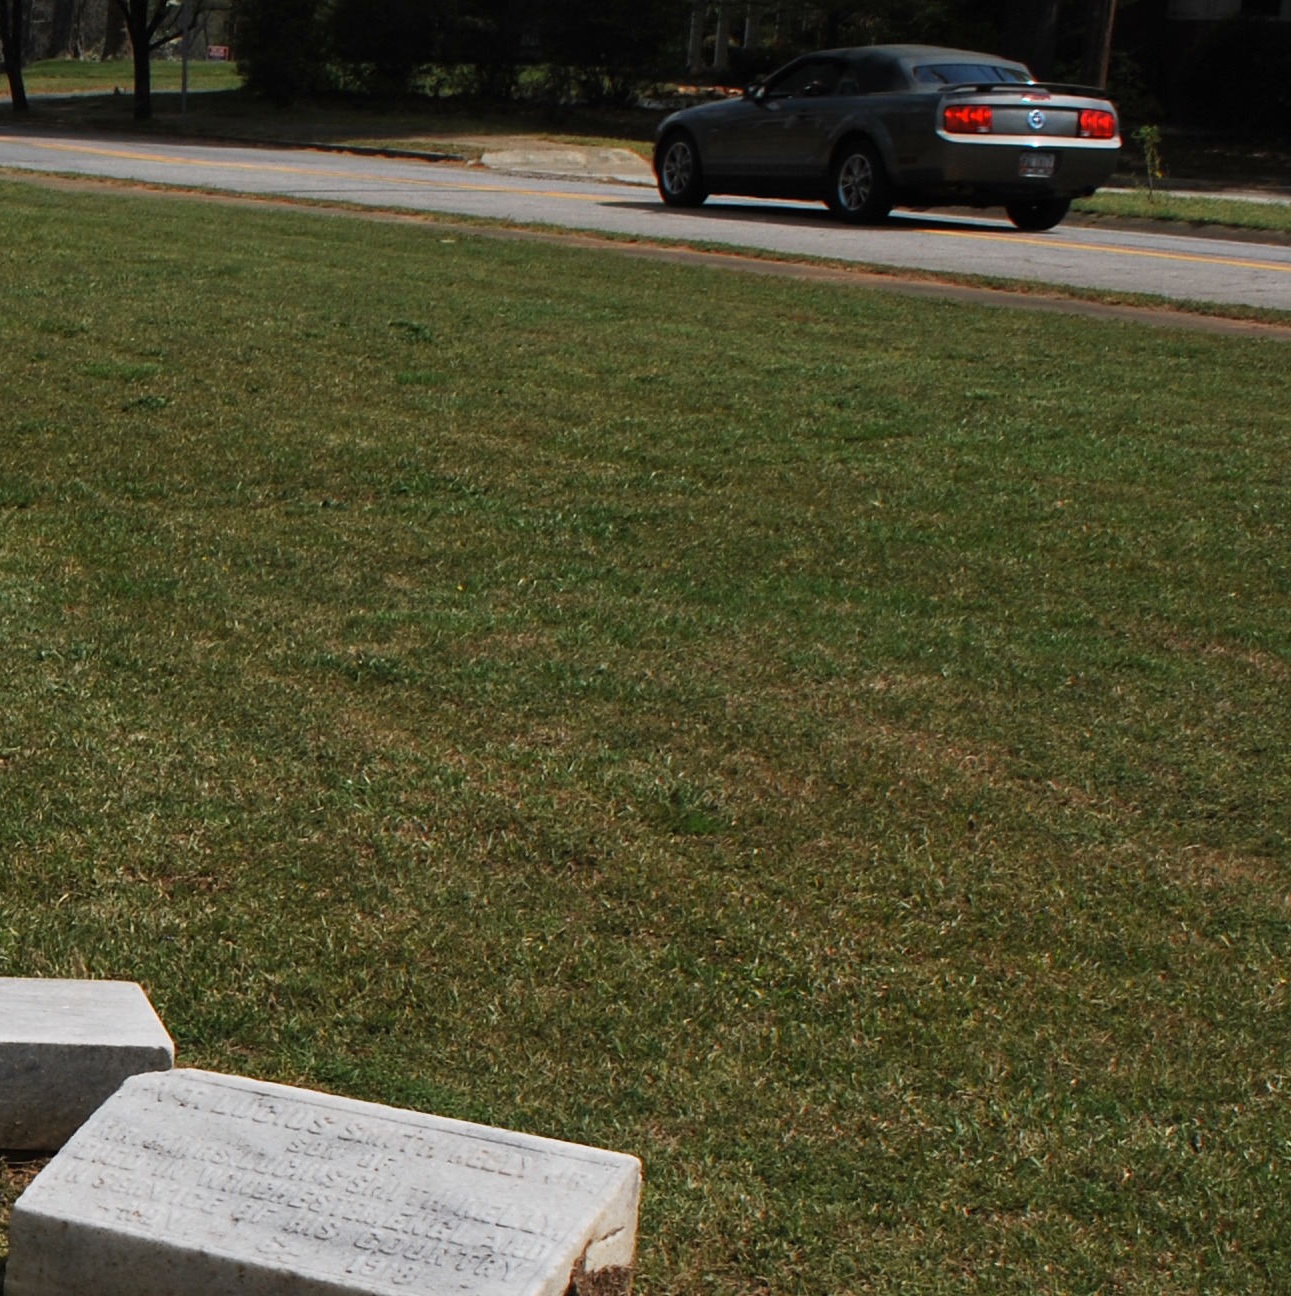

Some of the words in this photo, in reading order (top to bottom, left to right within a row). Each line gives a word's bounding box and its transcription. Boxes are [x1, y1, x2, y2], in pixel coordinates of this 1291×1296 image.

[71, 1141, 148, 1171] DIED
[150, 1158, 189, 1180] IN
[283, 1136, 344, 1161] SON
[52, 1163, 89, 1183] IN
[89, 1170, 227, 1214] SERVICE
[228, 1200, 280, 1226] OF
[279, 1212, 345, 1242] HIS
[342, 1253, 424, 1287] 1918
